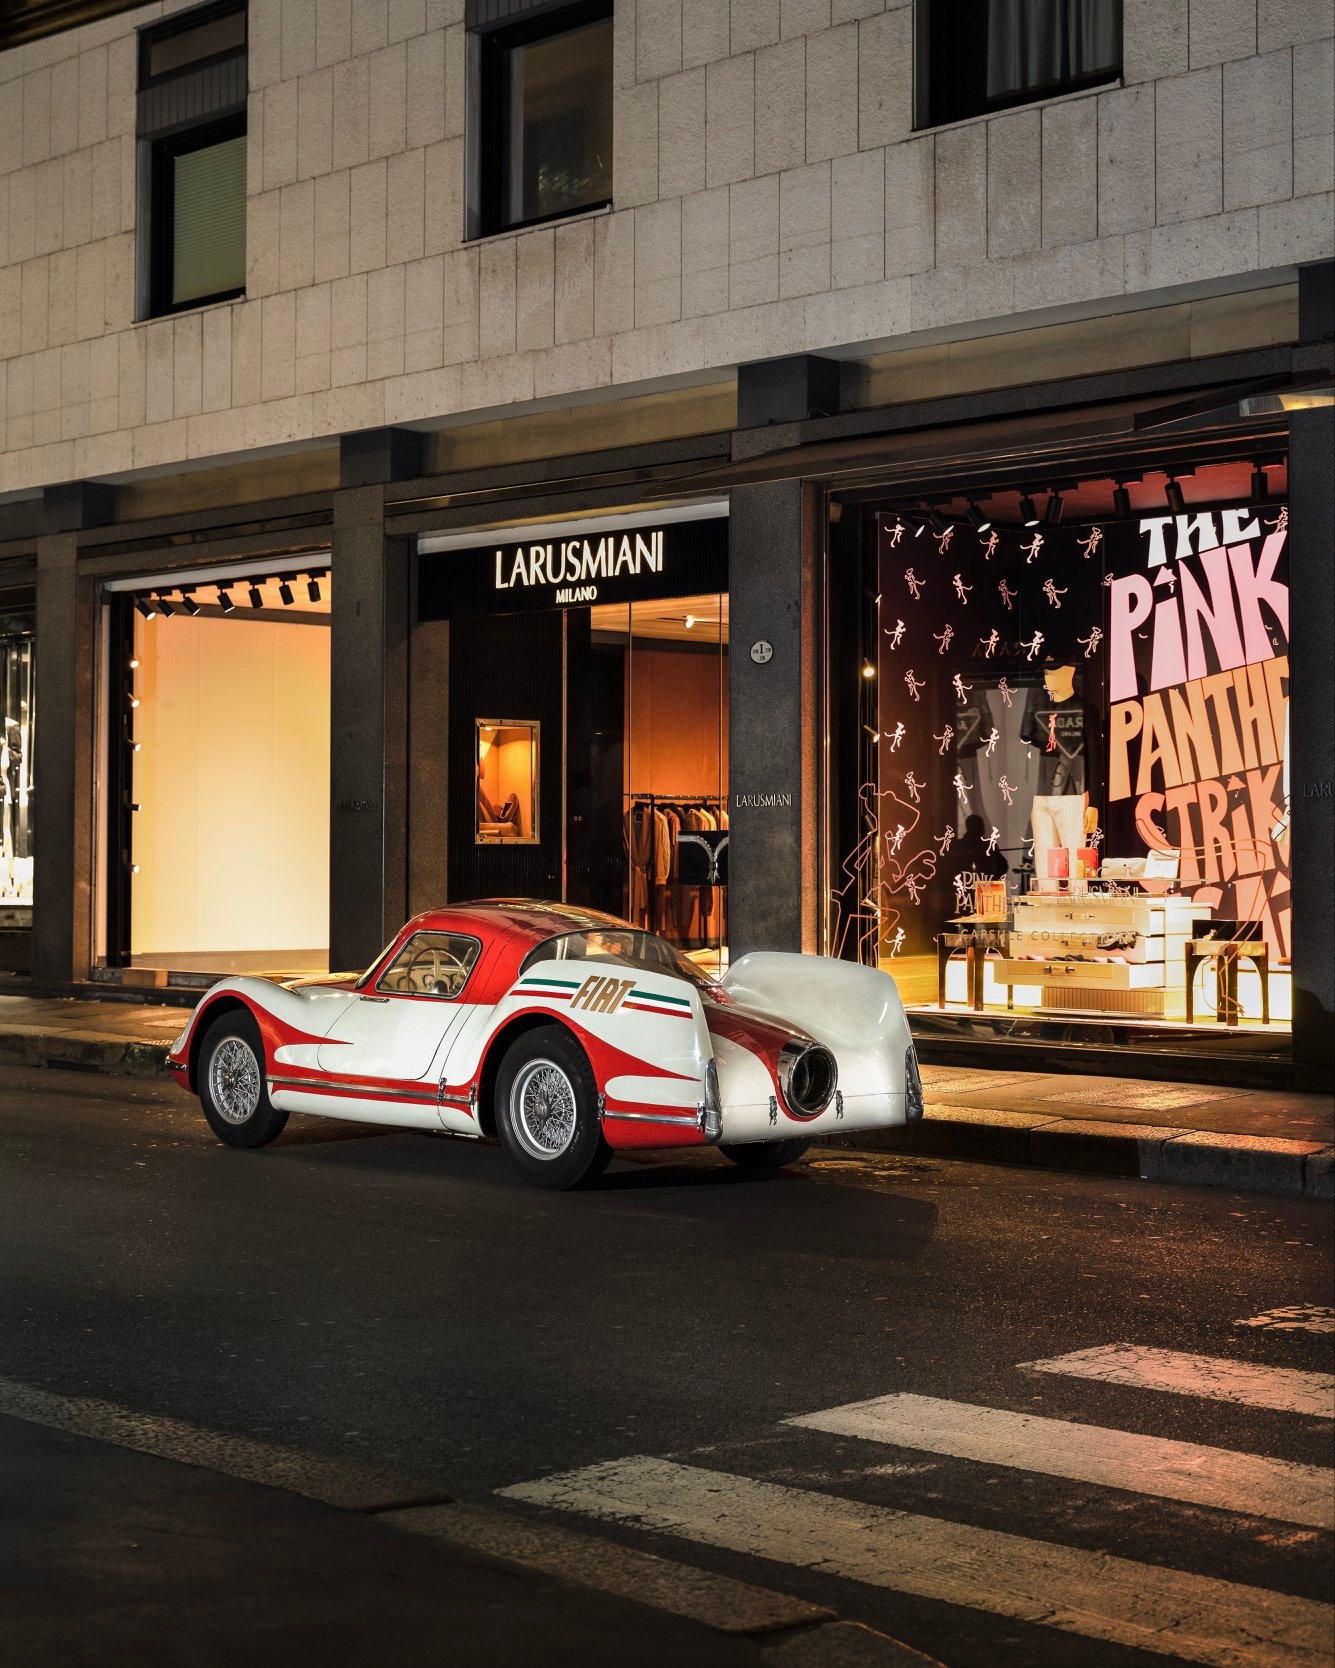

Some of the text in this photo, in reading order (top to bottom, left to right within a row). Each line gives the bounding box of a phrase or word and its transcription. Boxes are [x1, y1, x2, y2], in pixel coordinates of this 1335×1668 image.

[1139, 508, 1261, 568] THE
[495, 531, 664, 589] LARUSMIANI
[555, 585, 598, 603] MILANO
[736, 793, 792, 807] LARUSMIANI
[954, 892, 1021, 914] PANTHER
[570, 975, 637, 1014] FIAT
